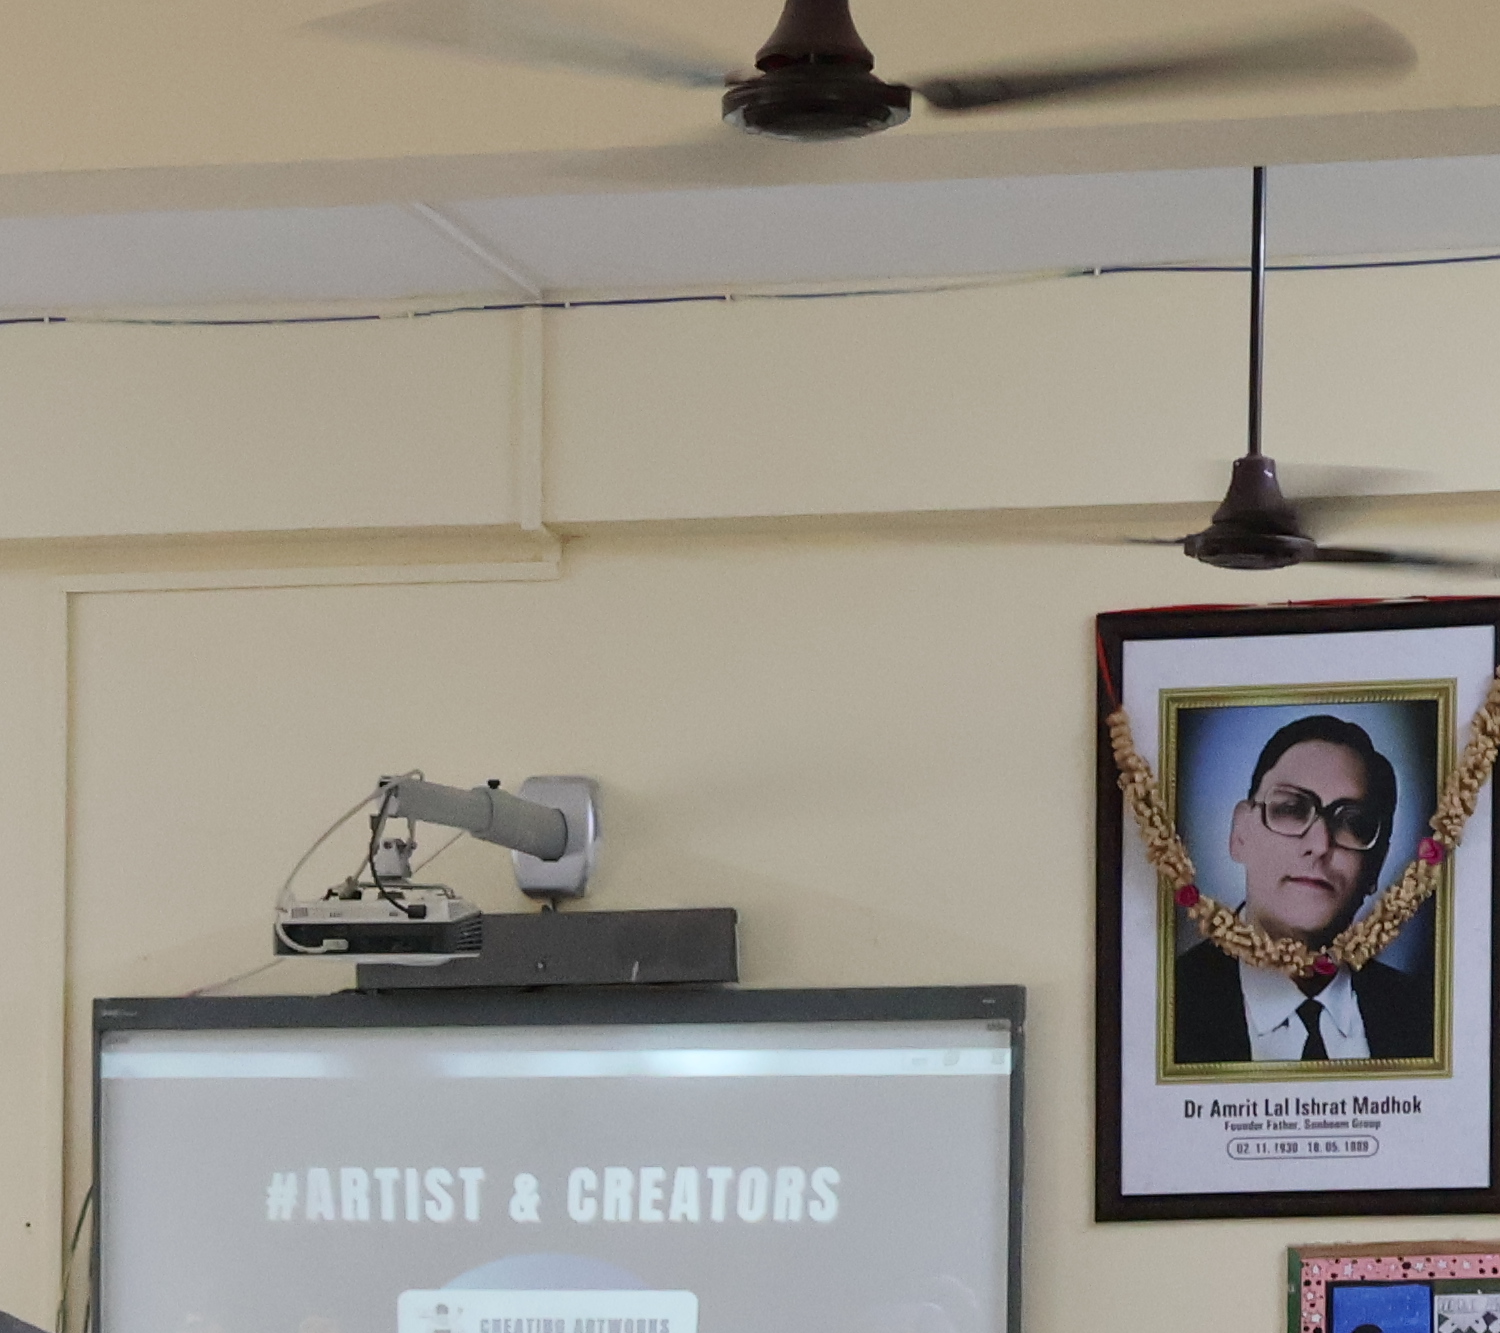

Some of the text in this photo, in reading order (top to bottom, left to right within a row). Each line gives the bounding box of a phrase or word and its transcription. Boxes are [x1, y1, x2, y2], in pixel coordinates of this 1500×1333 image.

[1184, 1095, 1422, 1118] Dr Amrit Lal Ishrat Madhok
[1224, 1120, 1263, 1131] Founder
[1304, 1118, 1350, 1130] Sunbeam
[1352, 1117, 1382, 1131] Group
[265, 1165, 842, 1224] #ARTIST & CREATORS
